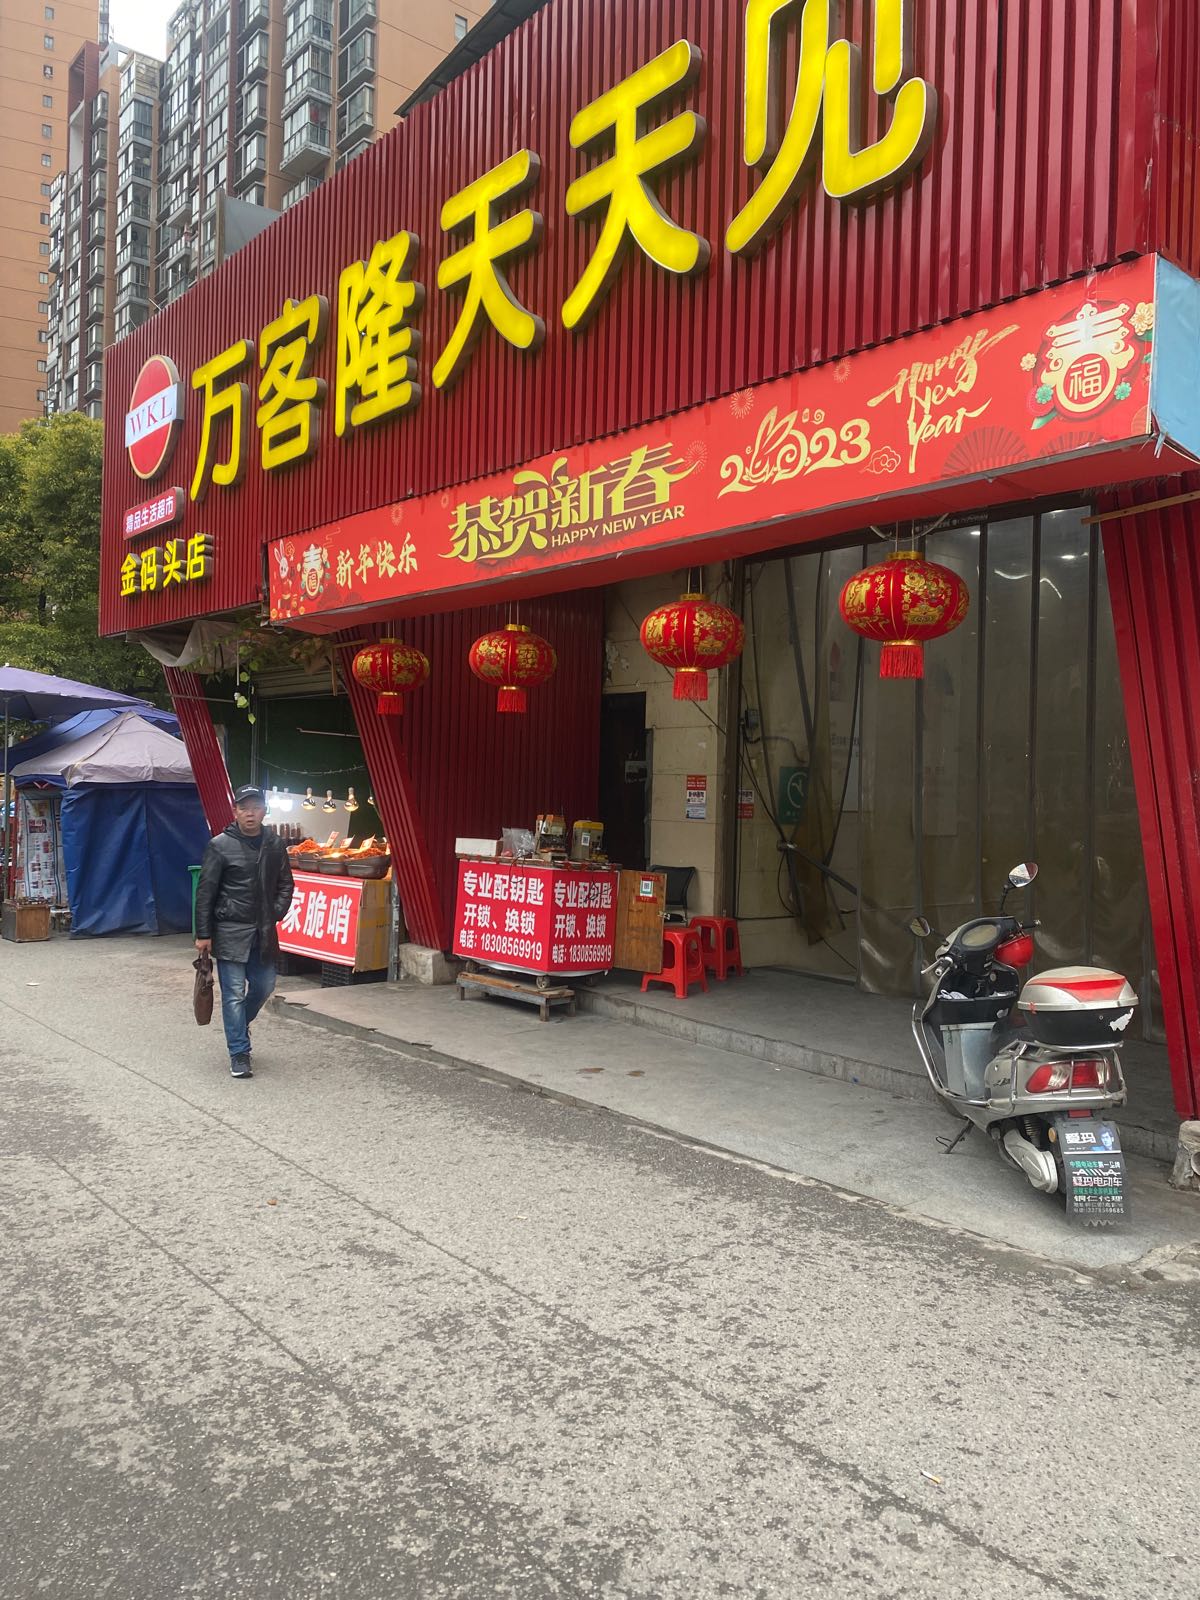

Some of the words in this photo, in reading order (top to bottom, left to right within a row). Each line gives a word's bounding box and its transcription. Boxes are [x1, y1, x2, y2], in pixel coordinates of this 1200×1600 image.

[191, 0, 928, 502] 万客隆天天见
[1069, 357, 1103, 400] 福
[129, 394, 174, 438] WKL
[717, 408, 871, 499] 2023
[126, 496, 174, 534] 精品生活超市
[438, 442, 700, 563] 恭贺新春
[551, 524, 599, 548] HAPPY
[602, 515, 637, 537] NEW
[640, 504, 685, 527] YEAR
[120, 532, 208, 597] 金码头店
[336, 532, 418, 590] 新年快乐
[463, 870, 544, 906] 专业配钥匙
[554, 880, 612, 909] 专业配钥匙
[463, 903, 536, 936] 开锁、换锁
[554, 914, 606, 939] 开锁、换锁
